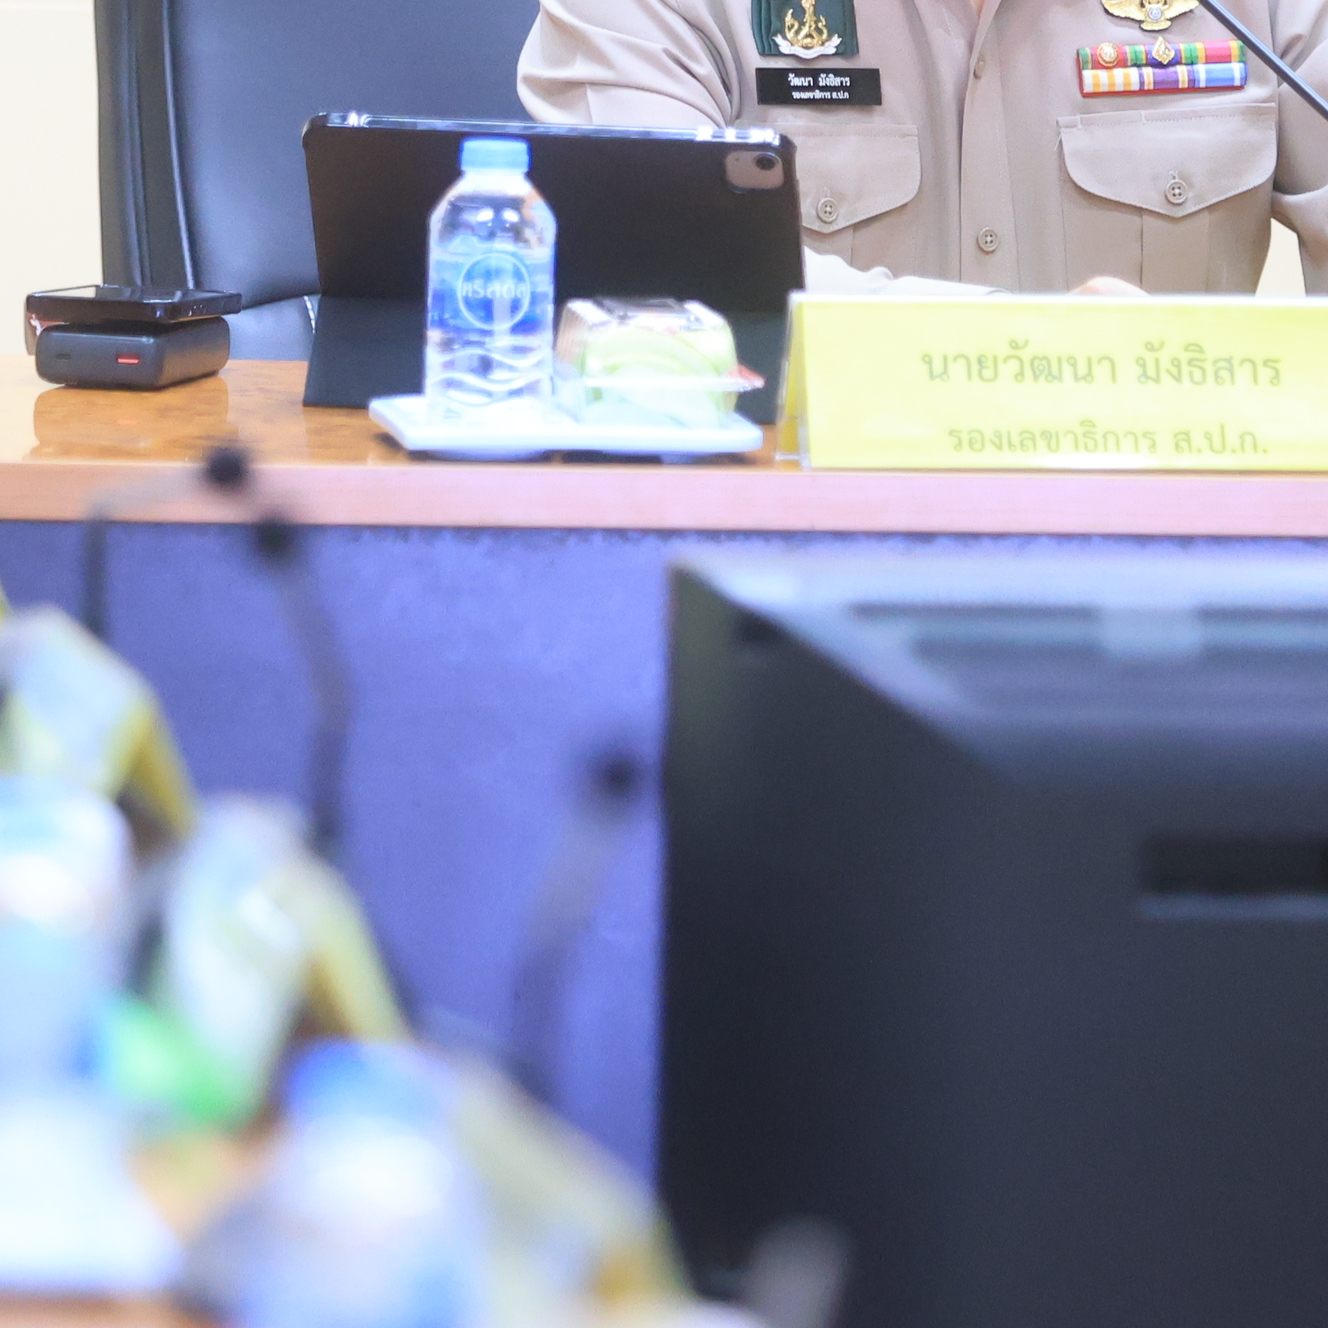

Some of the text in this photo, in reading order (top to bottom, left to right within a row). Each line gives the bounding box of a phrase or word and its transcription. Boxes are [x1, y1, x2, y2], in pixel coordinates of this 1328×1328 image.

[787, 72, 851, 87] วัฒนา มังธิสาร
[920, 337, 1283, 387] นายวัฒนา มังธิสาร
[947, 419, 1270, 455] รองเลขาธิการ ส.ป.ก.
